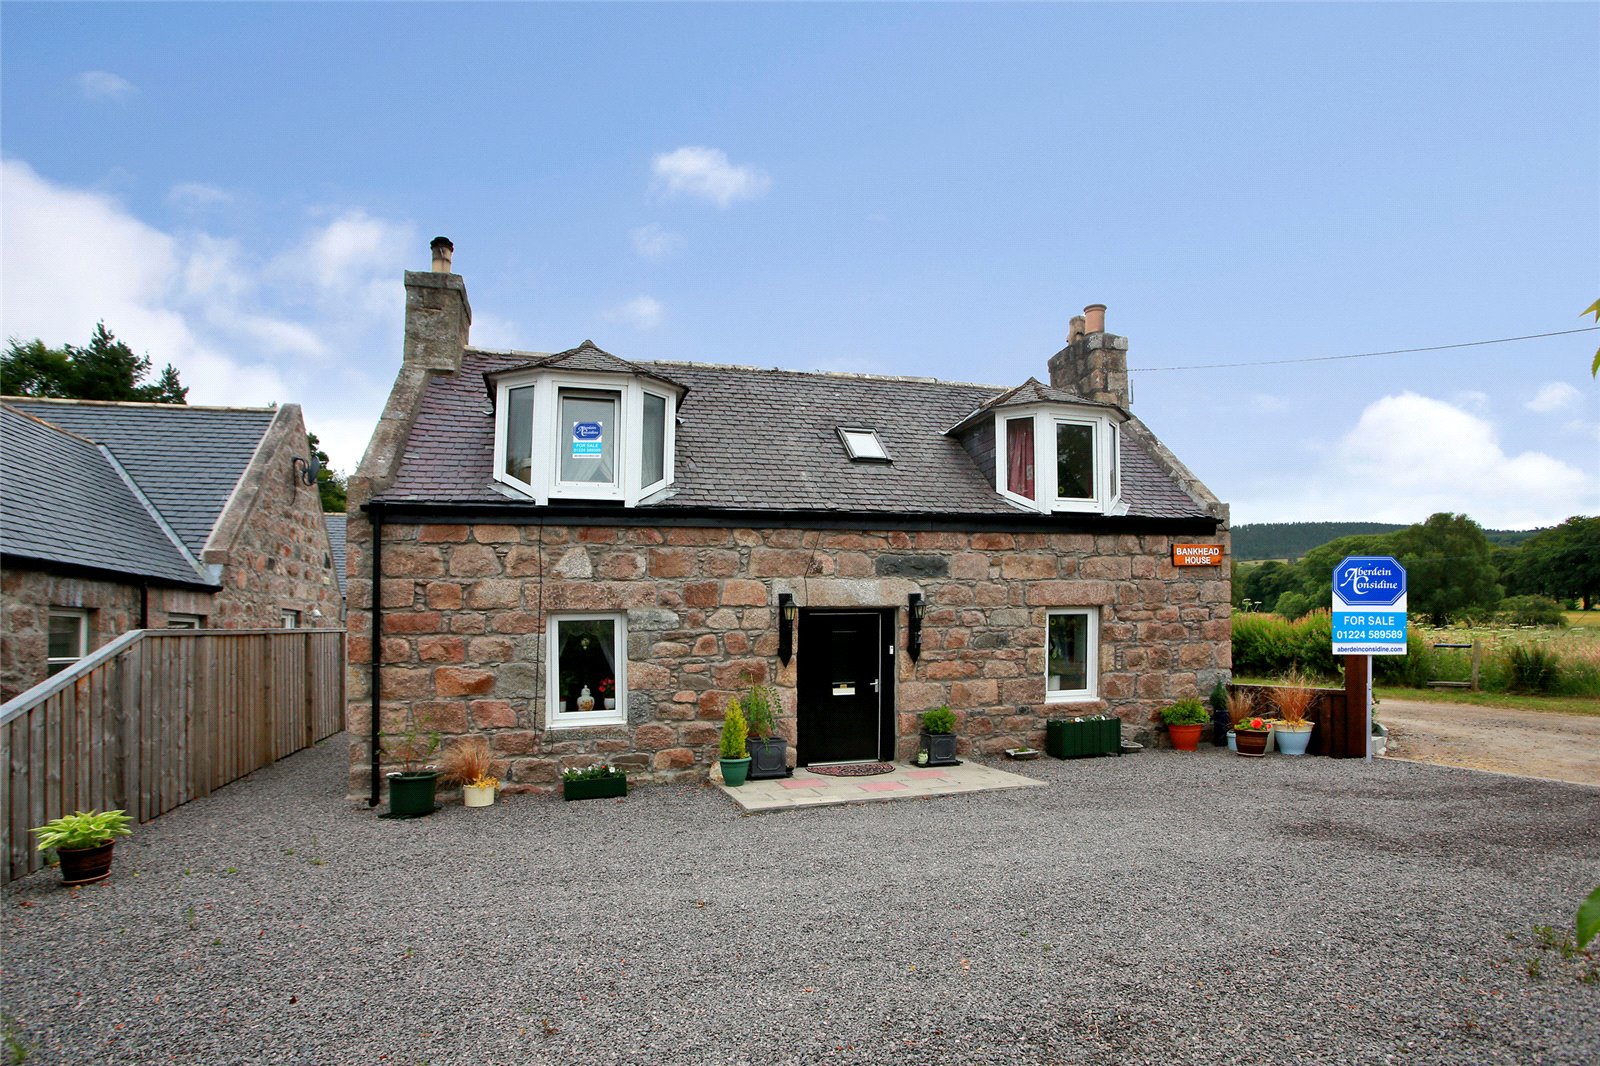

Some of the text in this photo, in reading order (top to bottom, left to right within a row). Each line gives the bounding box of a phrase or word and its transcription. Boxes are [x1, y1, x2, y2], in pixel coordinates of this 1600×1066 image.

[1176, 548, 1220, 556] BANKHEAD
[1184, 556, 1211, 564] HOUSE
[1340, 566, 1392, 587] Aberdein
[1353, 576, 1398, 594] Considine
[1344, 616, 1394, 626] FOR SALE
[1336, 630, 1402, 639] 01224 589589
